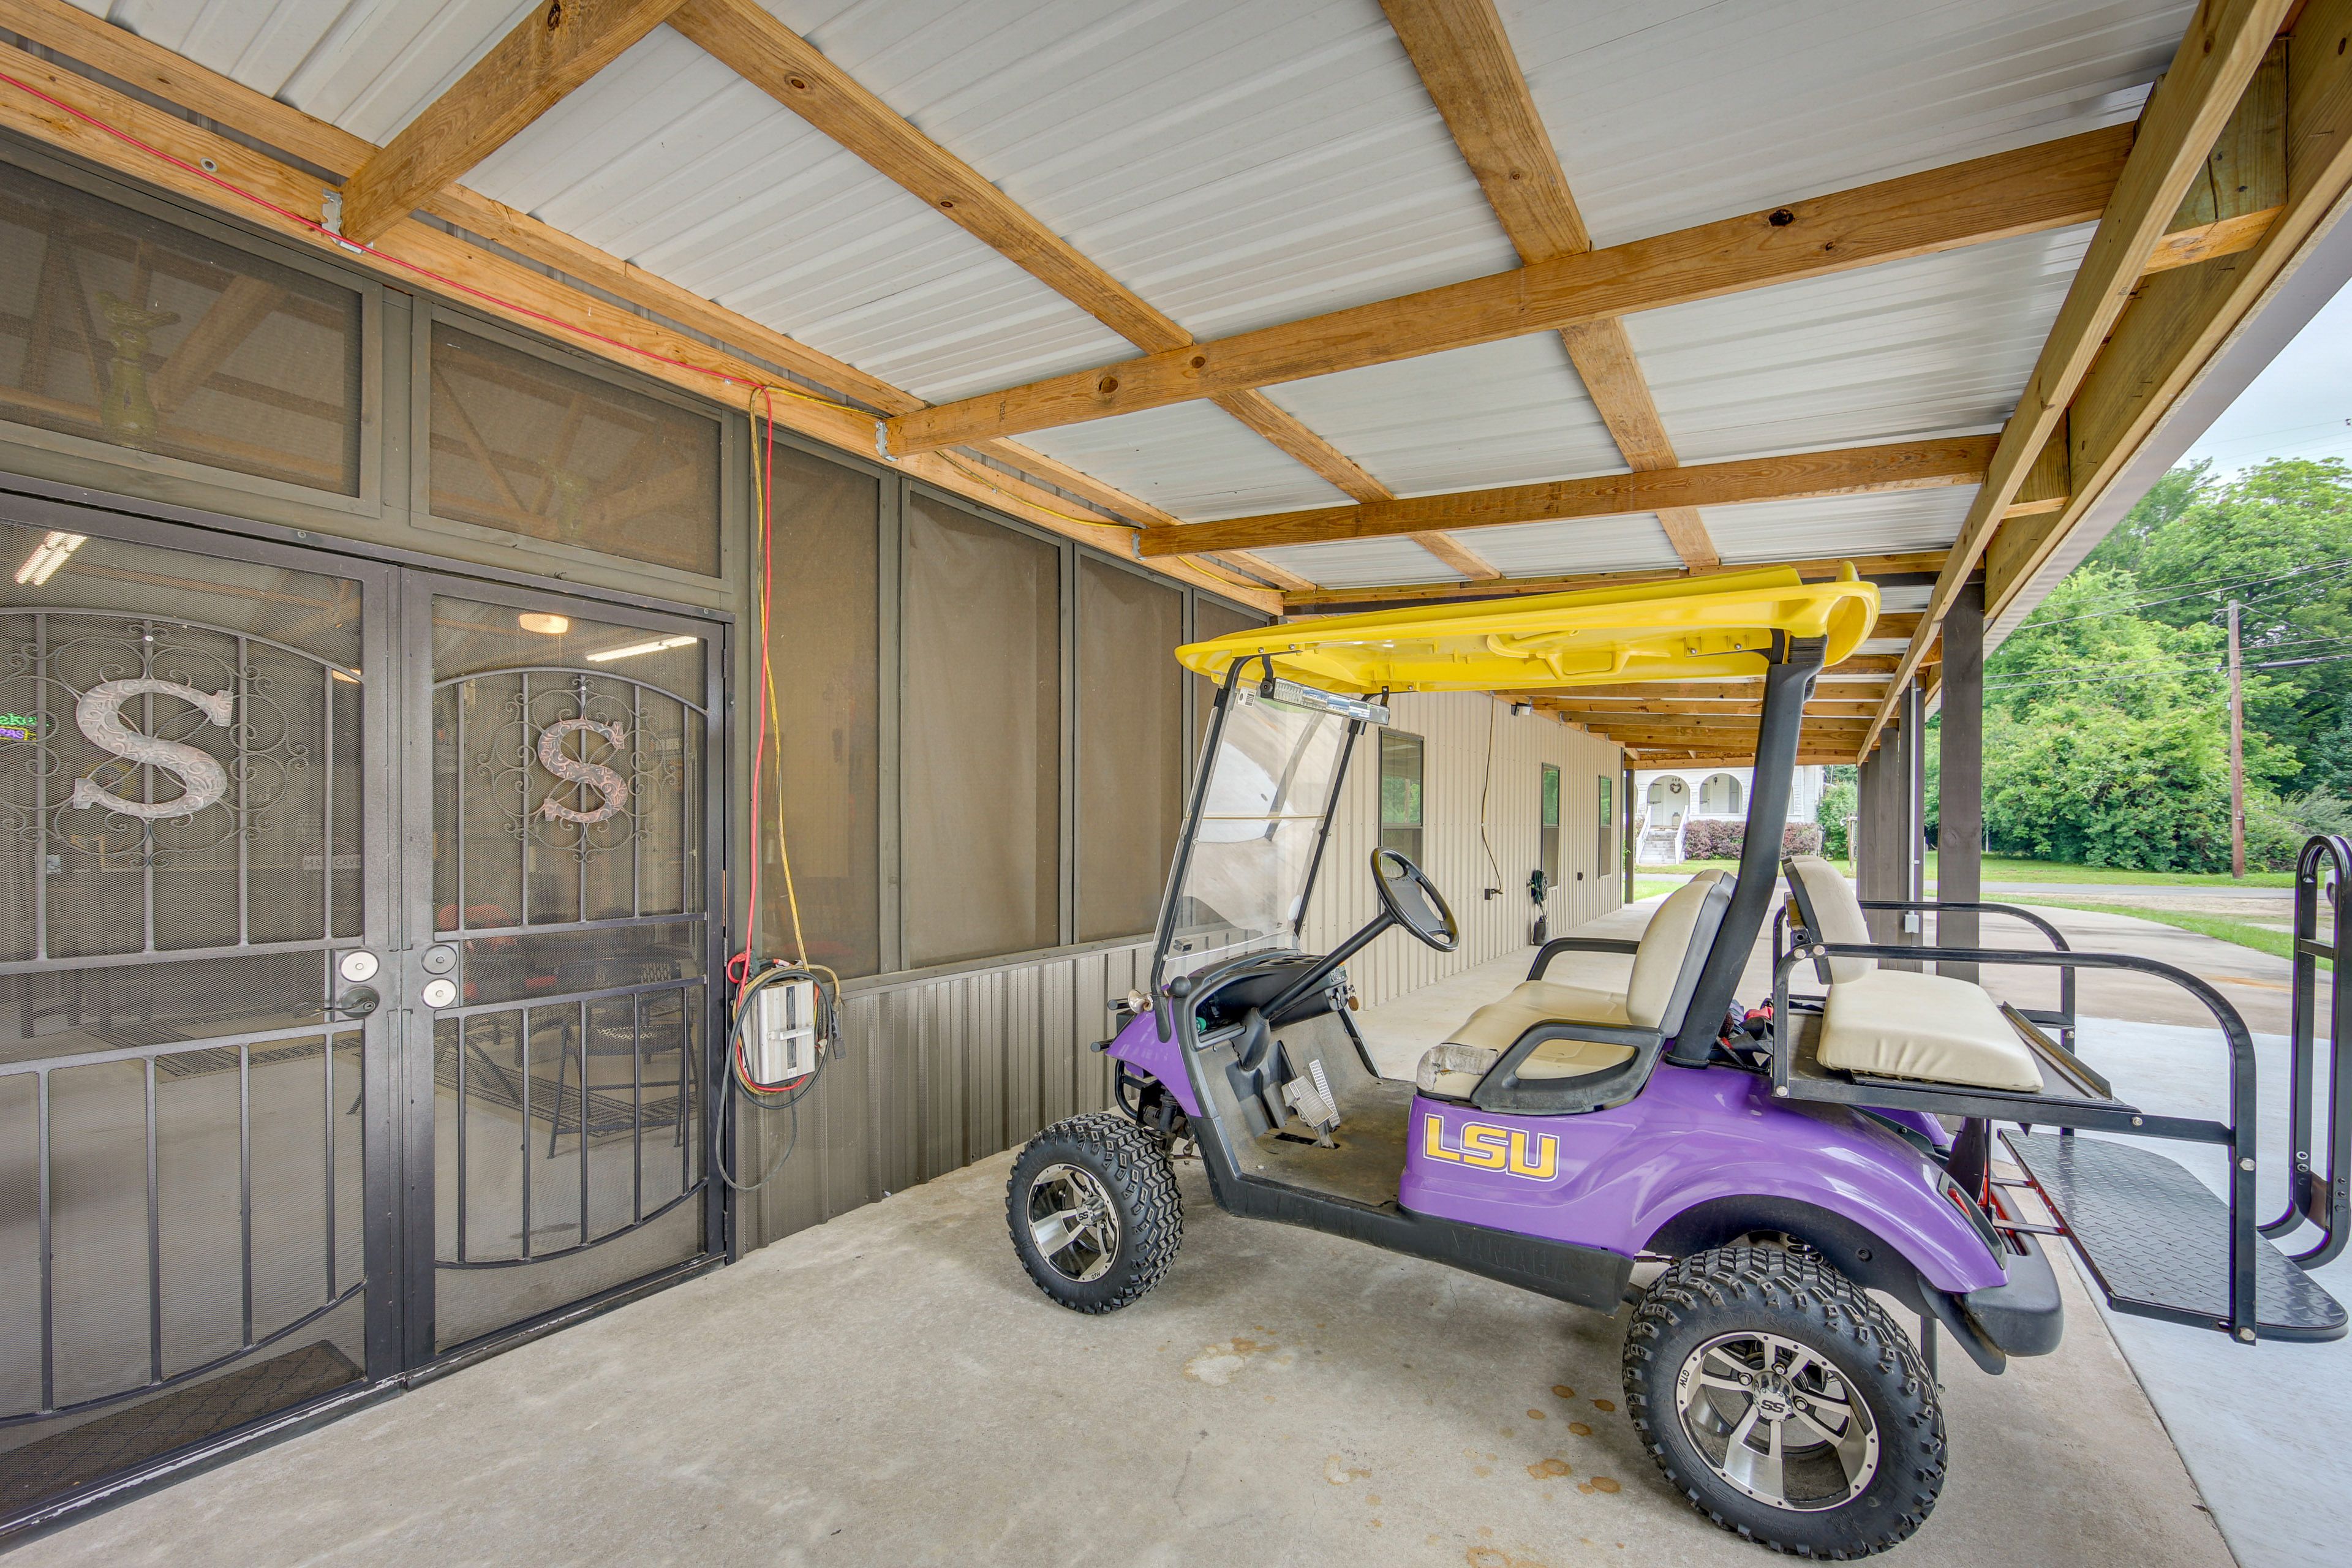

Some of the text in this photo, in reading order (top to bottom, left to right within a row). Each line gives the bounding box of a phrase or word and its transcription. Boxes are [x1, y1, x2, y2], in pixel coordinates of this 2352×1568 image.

[73, 679, 233, 818] S
[537, 719, 628, 823] S
[1423, 1112, 1560, 1182] LSU
[1078, 1211, 1089, 1221] SS
[1091, 1271, 1101, 1280] GTW
[1679, 1369, 1690, 1389] GTW
[1760, 1399, 1785, 1414] SS
